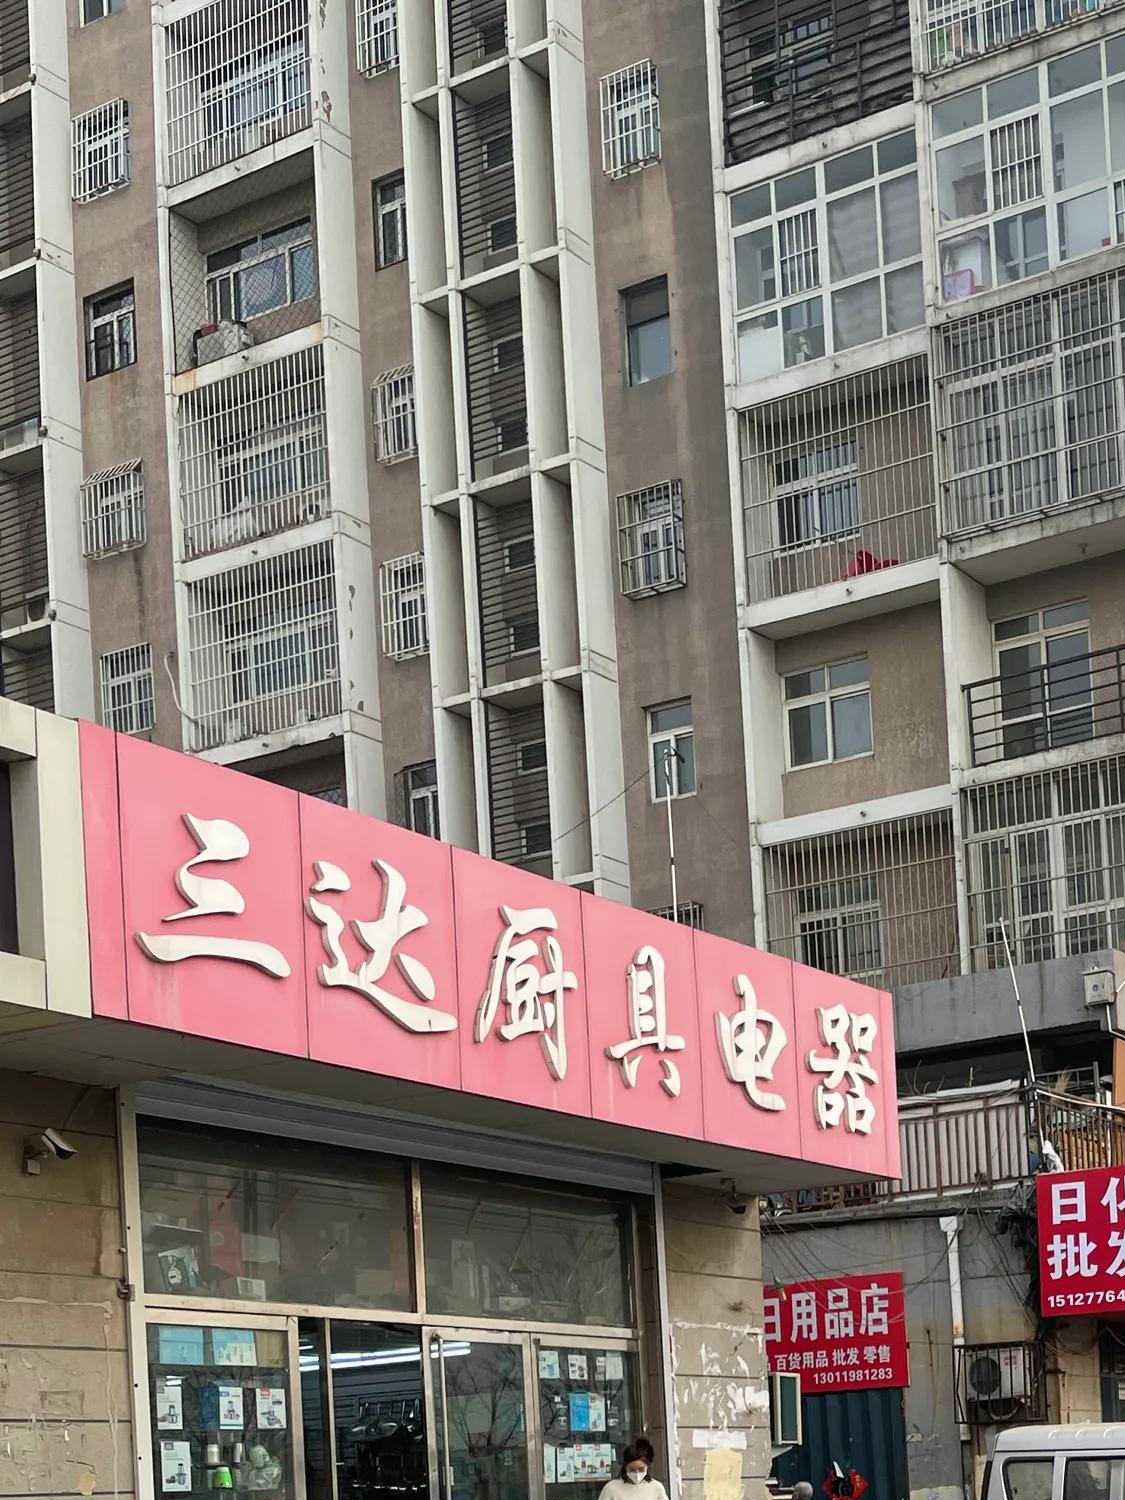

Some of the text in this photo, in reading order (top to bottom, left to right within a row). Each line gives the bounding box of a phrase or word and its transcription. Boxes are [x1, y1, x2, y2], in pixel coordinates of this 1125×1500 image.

[134, 812, 880, 1136] 三达厨具电器
[763, 1283, 889, 1343] 日用品店
[774, 1350, 828, 1371] 百货用品
[832, 1347, 859, 1366] 批发
[863, 1345, 891, 1364] 零售
[813, 1368, 893, 1384] 13011981283
